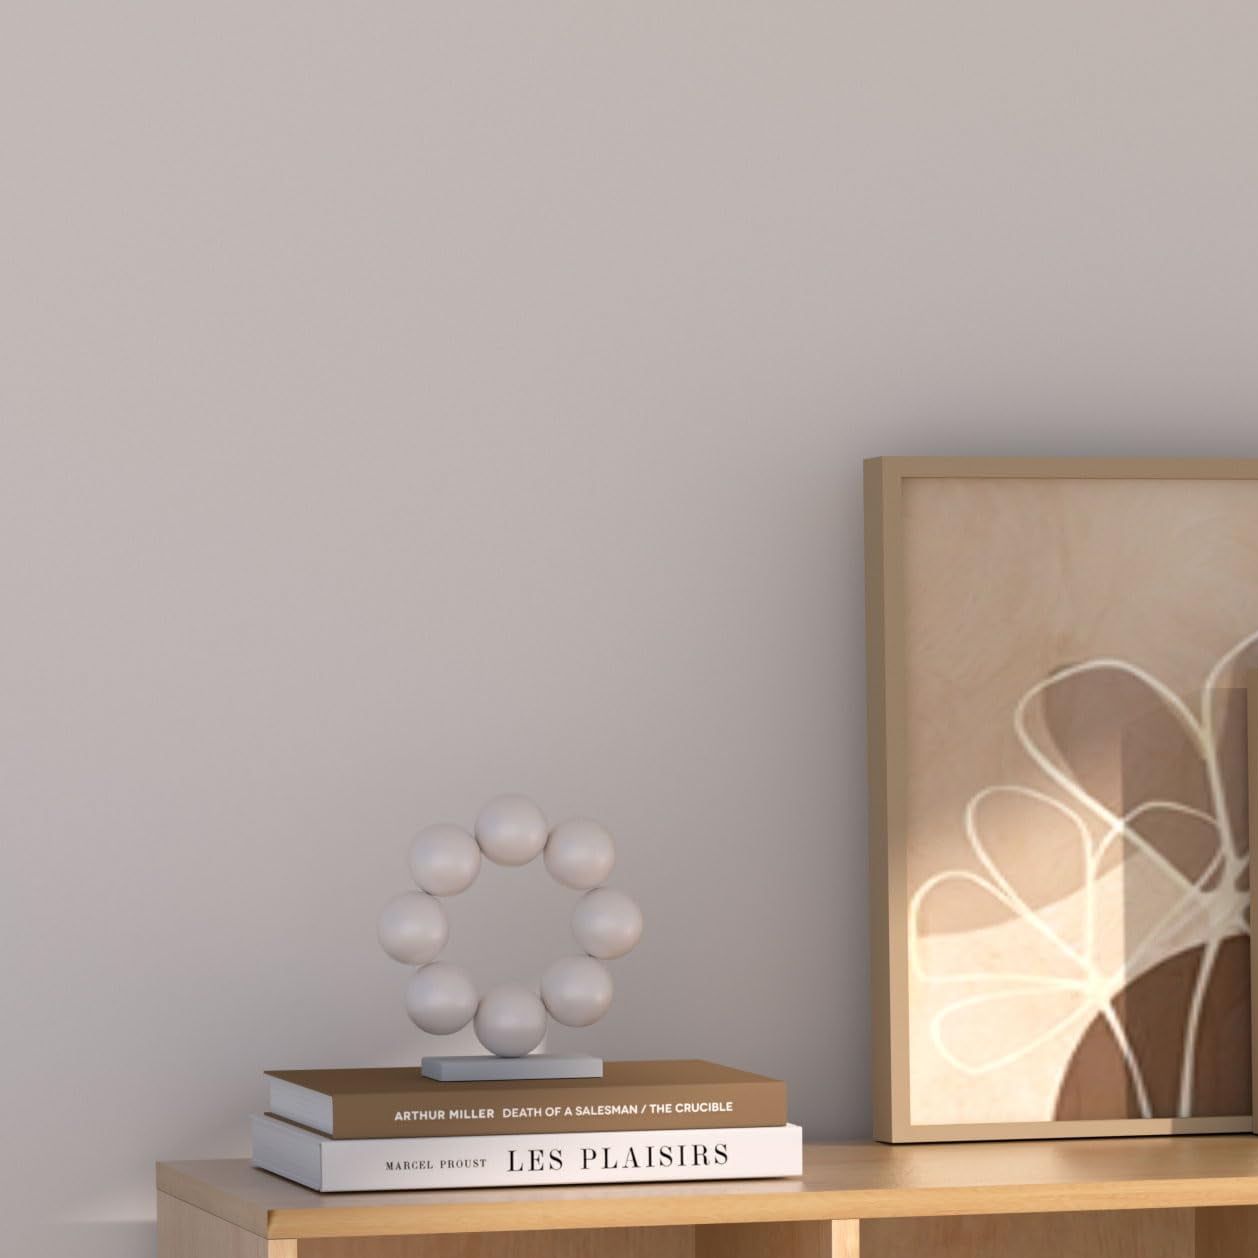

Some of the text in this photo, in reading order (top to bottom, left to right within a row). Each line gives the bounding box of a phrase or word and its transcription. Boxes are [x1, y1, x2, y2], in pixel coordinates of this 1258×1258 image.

[394, 1109, 445, 1122] ARTHUR
[449, 1107, 494, 1120] MILLER
[503, 1106, 541, 1118] DEATH
[545, 1106, 561, 1117] OF
[564, 1105, 573, 1116] A
[576, 1104, 638, 1116] SALESMAN
[649, 1103, 671, 1115] THE
[676, 1102, 733, 1113] CRUCIBLE
[385, 1159, 487, 1171] MARCEL PROUST
[508, 1143, 729, 1173] LES PLAISIRS
